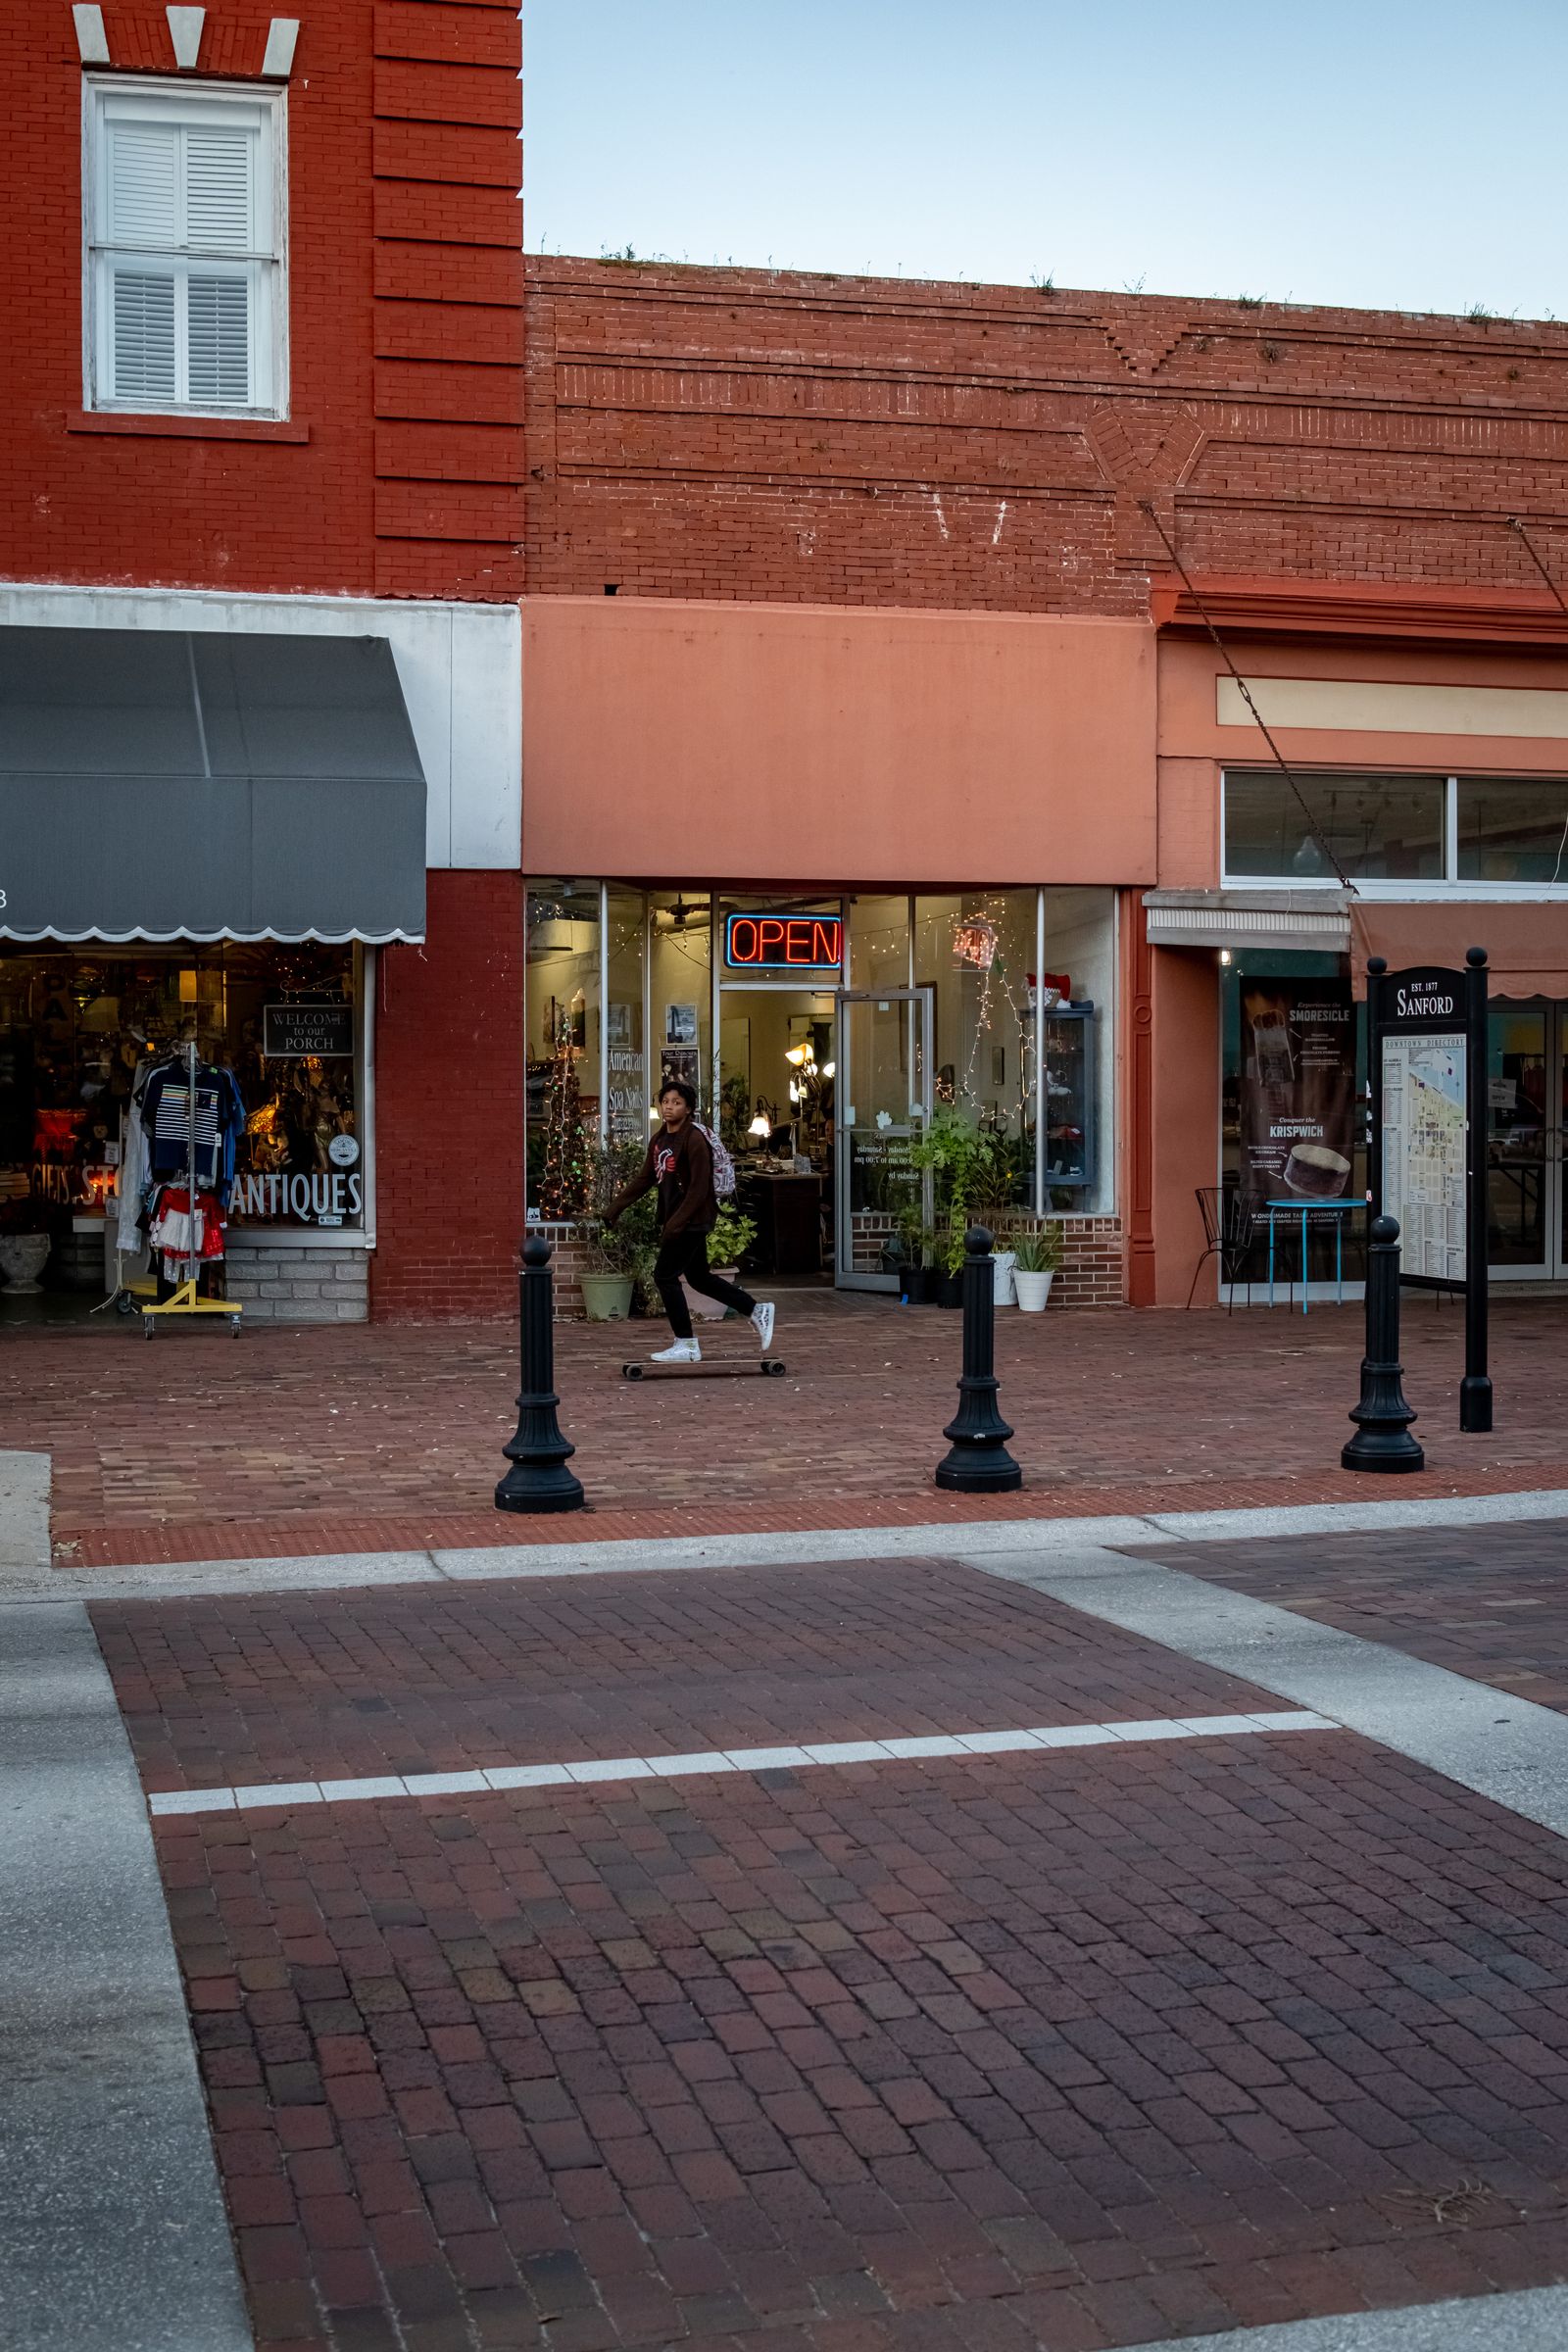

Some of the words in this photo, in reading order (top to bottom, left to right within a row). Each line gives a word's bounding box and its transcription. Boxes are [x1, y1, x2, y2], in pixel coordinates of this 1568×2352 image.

[732, 919, 838, 963] OPEN
[1411, 983, 1424, 993] EST.
[1396, 988, 1453, 1016] SANFORD
[272, 1012, 346, 1026] WELCOME
[1289, 1009, 1350, 1022] SMORESICLE
[293, 1027, 305, 1036] to
[307, 1027, 325, 1036] our
[284, 1037, 334, 1051] PORCH
[609, 1086, 624, 1113] Spa
[1279, 1116, 1304, 1125] Conquer
[1269, 1125, 1324, 1138] KRISPWICH
[228, 1173, 362, 1222] ANTIQUES
